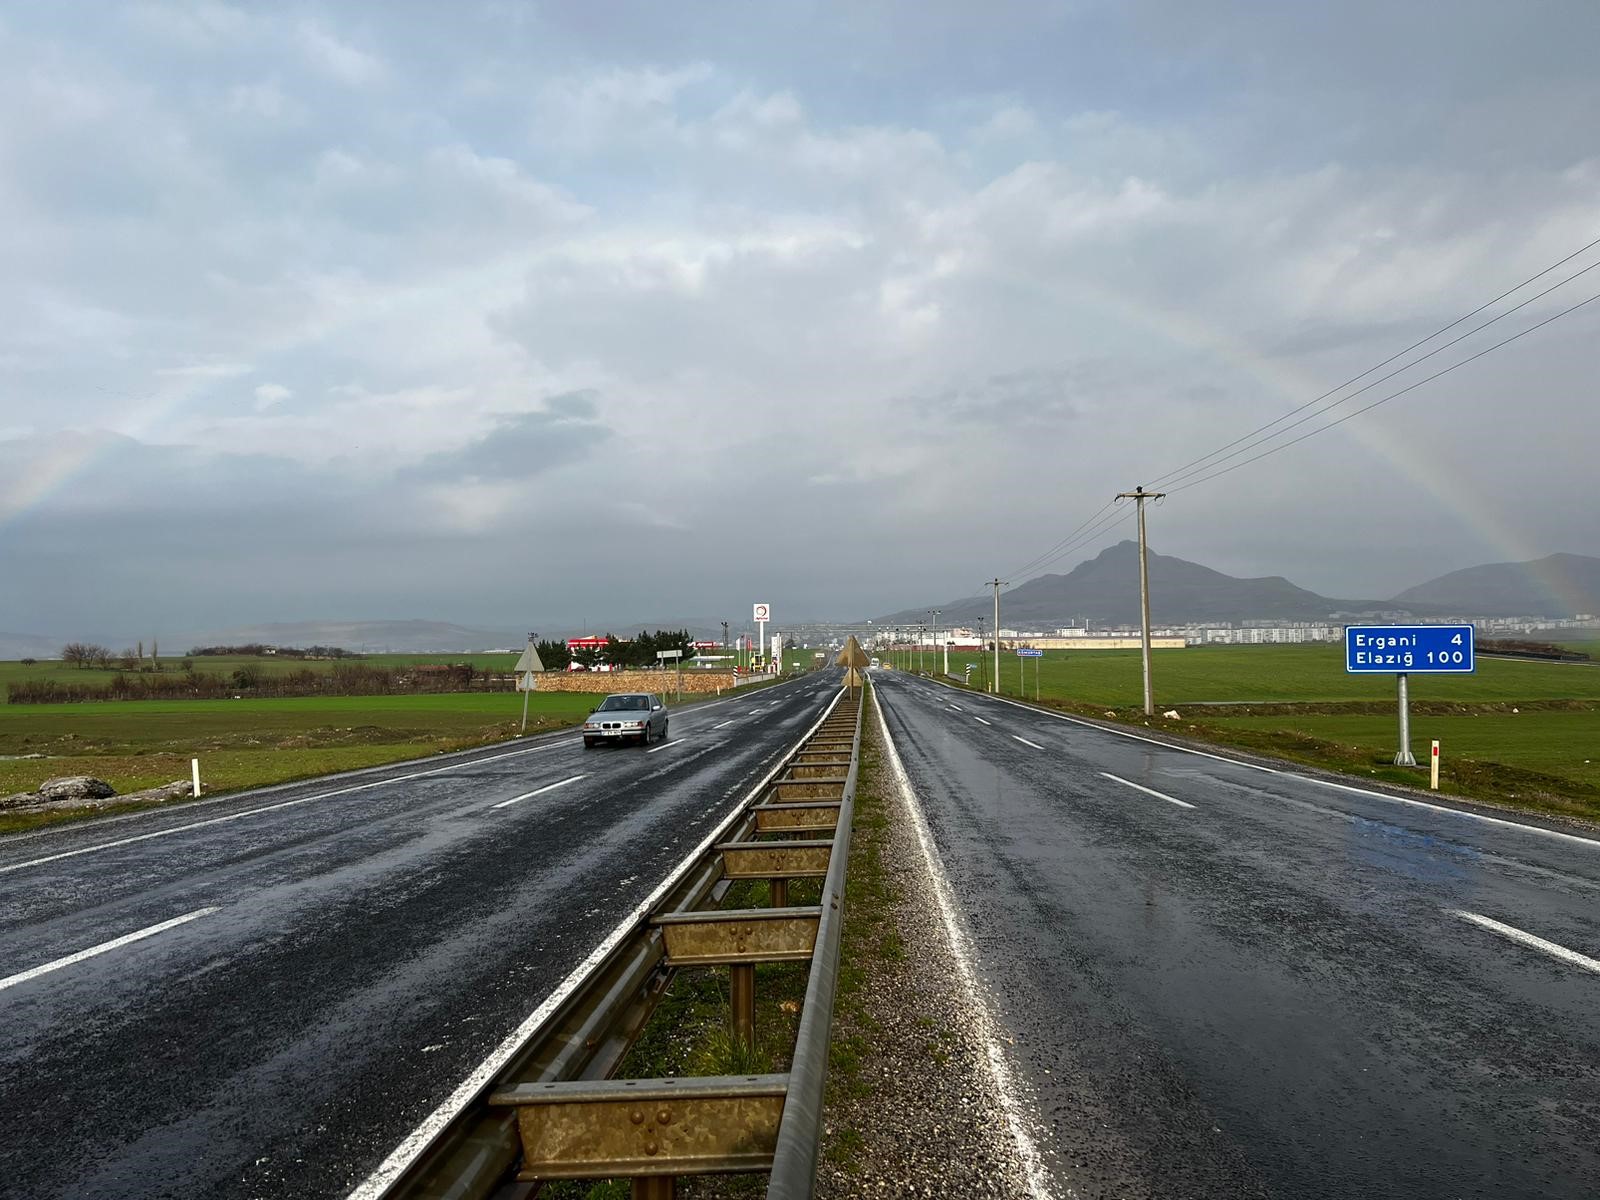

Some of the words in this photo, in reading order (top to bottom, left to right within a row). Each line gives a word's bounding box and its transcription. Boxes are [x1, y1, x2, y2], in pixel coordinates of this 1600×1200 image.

[1356, 634, 1416, 649] Ergani
[1451, 633, 1463, 646] 4
[1356, 651, 1413, 666] Elazığ
[1427, 651, 1463, 664] 100
